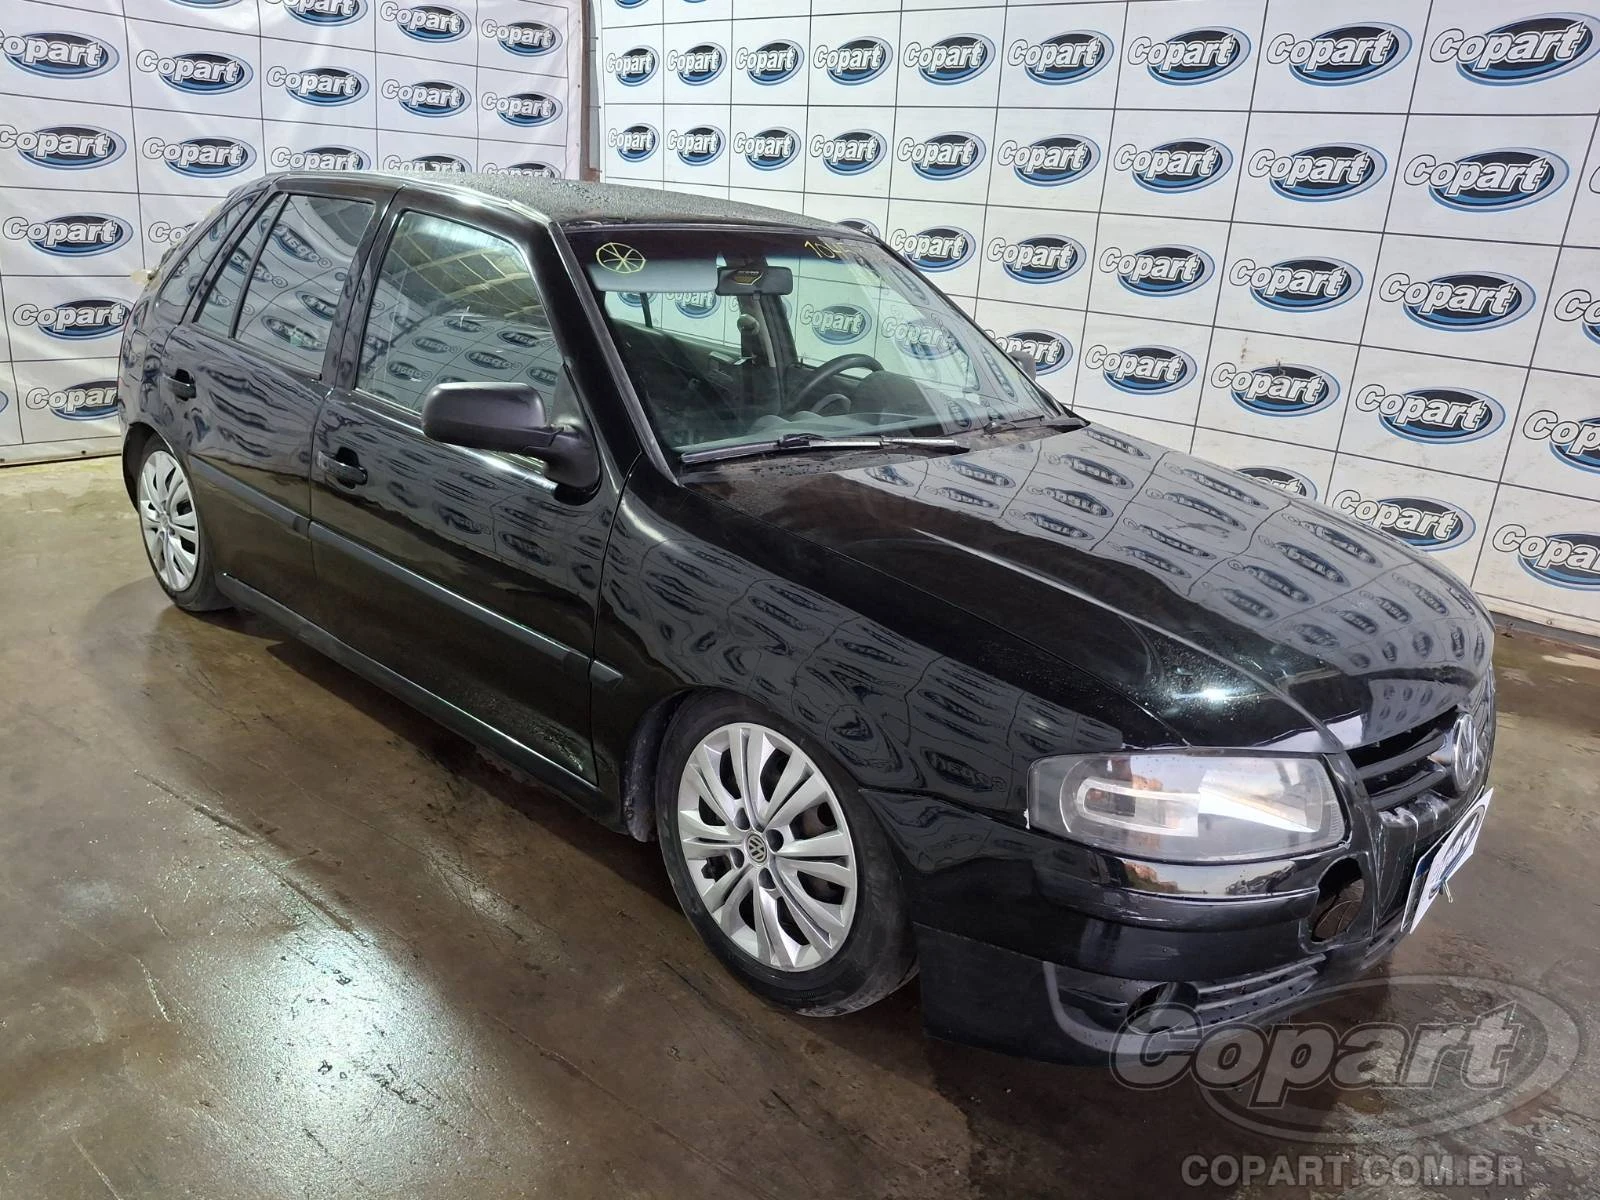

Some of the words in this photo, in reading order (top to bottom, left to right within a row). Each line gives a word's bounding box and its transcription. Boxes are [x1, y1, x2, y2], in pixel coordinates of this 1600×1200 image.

[266, 0, 355, 16] part
[380, 2, 461, 32] Copart
[0, 28, 102, 65] opart
[481, 19, 553, 47] Copart
[1430, 21, 1588, 71] Copart
[136, 49, 239, 83] Copart
[606, 51, 654, 78] Copart
[667, 48, 720, 76] Copart
[735, 45, 795, 76] Copart
[813, 43, 884, 75] Copart
[903, 41, 983, 73] Copart
[1007, 37, 1101, 72] Copart
[1127, 34, 1236, 73] Copart
[1266, 30, 1394, 72] Copart
[266, 66, 358, 96] Copart
[381, 79, 461, 107] Copart
[481, 92, 553, 117] Copart
[0, 125, 110, 158] Copart
[142, 137, 243, 167] Copart
[608, 128, 654, 151] Copart
[667, 129, 718, 154] Copart
[733, 132, 792, 160] Copart
[810, 135, 878, 162] Copart
[897, 137, 976, 168] Copart
[271, 147, 360, 171] Copart
[997, 140, 1089, 173] Copart
[1114, 144, 1220, 179] Copart
[1248, 149, 1372, 187] Copart
[1404, 154, 1550, 196] Copart
[3, 216, 117, 248] Copart
[890, 229, 965, 259] Copart
[987, 237, 1074, 269] Copart
[1099, 247, 1201, 282] Copart
[1229, 258, 1347, 297] Copart
[1379, 272, 1517, 315] Copart
[13, 303, 126, 331] Copart
[801, 304, 863, 335] Copart
[1085, 345, 1187, 382] Copart
[1211, 362, 1326, 404] Copart
[26, 388, 117, 413] Copar
[1355, 383, 1488, 431] Copart
[1523, 410, 1600, 454] Cop
[1332, 489, 1459, 540] Copart
[1492, 523, 1600, 570] Copa
